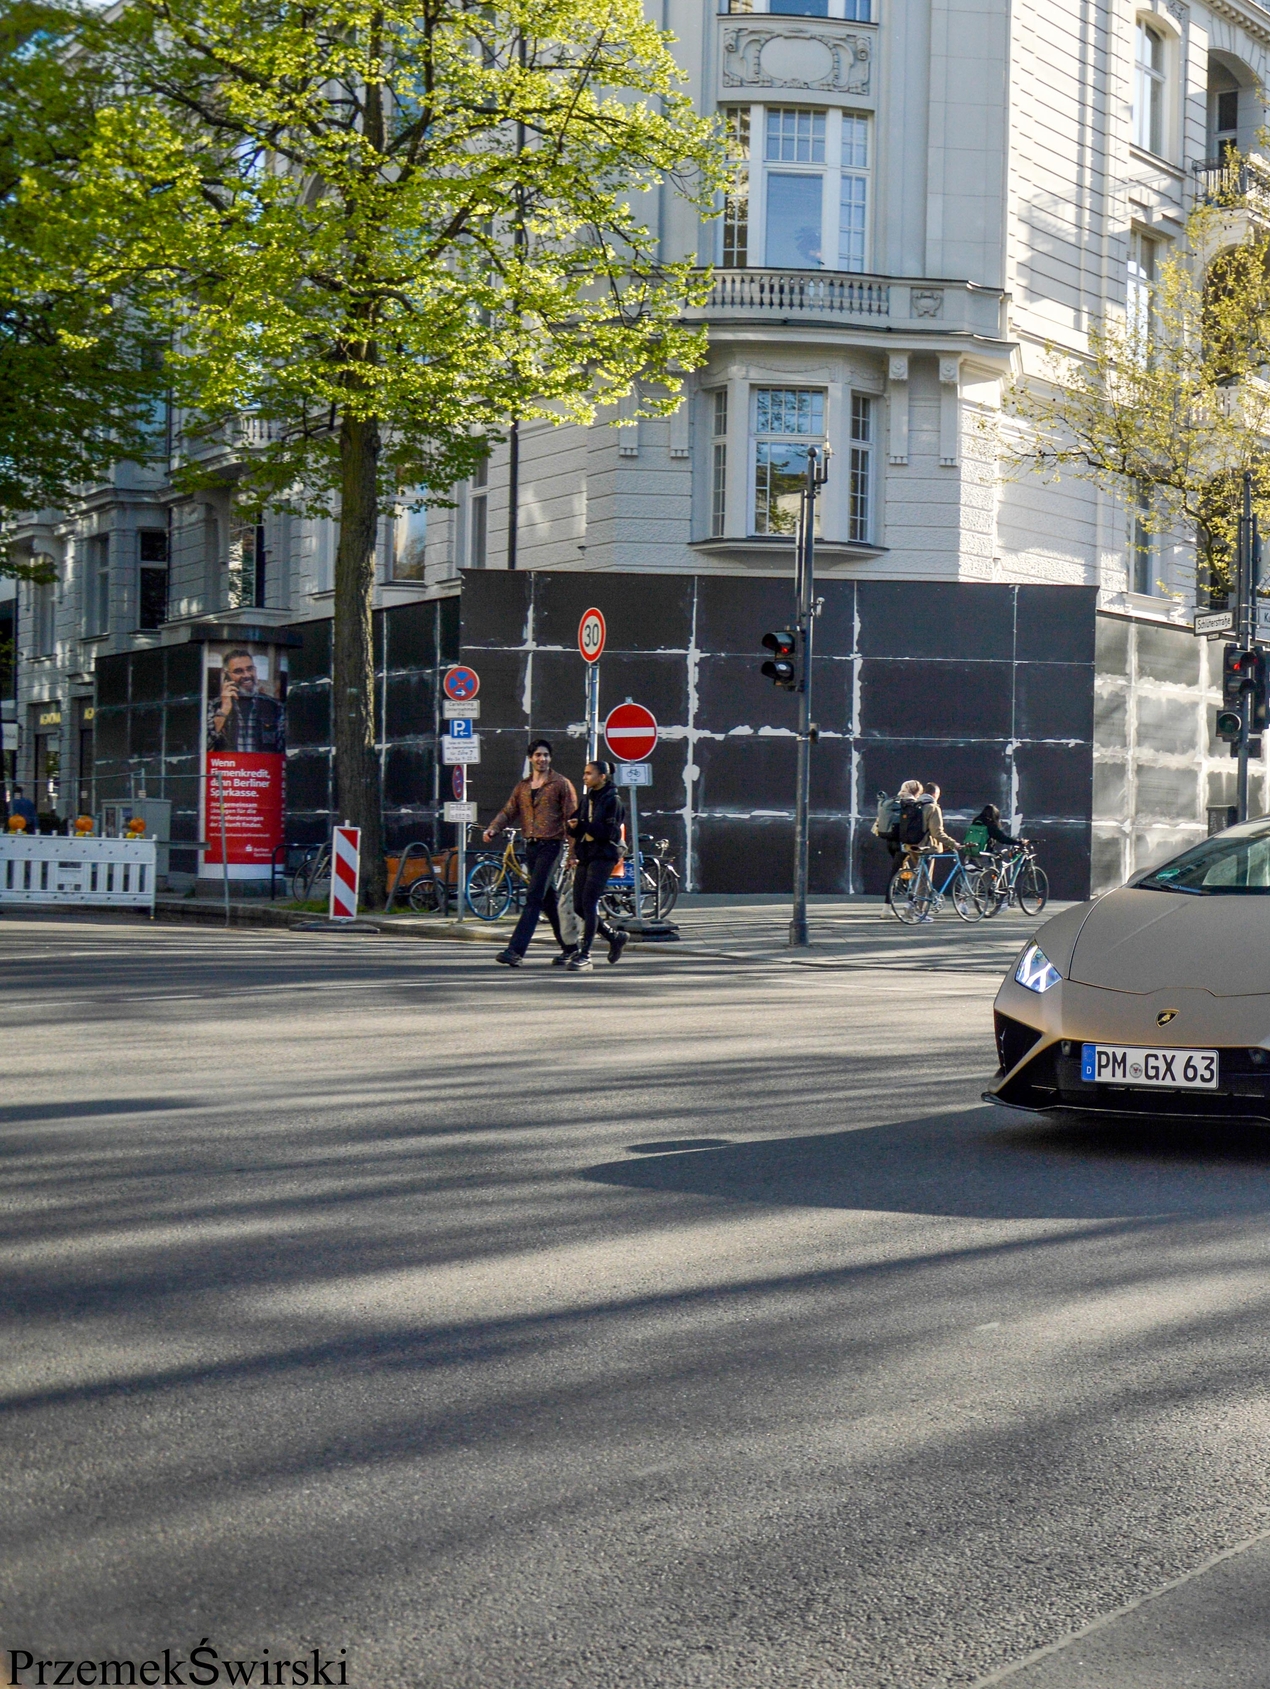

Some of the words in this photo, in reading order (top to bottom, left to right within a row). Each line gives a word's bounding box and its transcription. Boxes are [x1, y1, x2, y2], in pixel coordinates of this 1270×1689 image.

[584, 623, 599, 648] 30
[454, 721, 466, 737] P
[210, 759, 236, 767] Wenn
[233, 779, 270, 787] Berliner
[1086, 1066, 1092, 1074] D
[1097, 1051, 1127, 1078] PM
[1144, 1053, 1177, 1081] GX
[1183, 1055, 1215, 1083] 63
